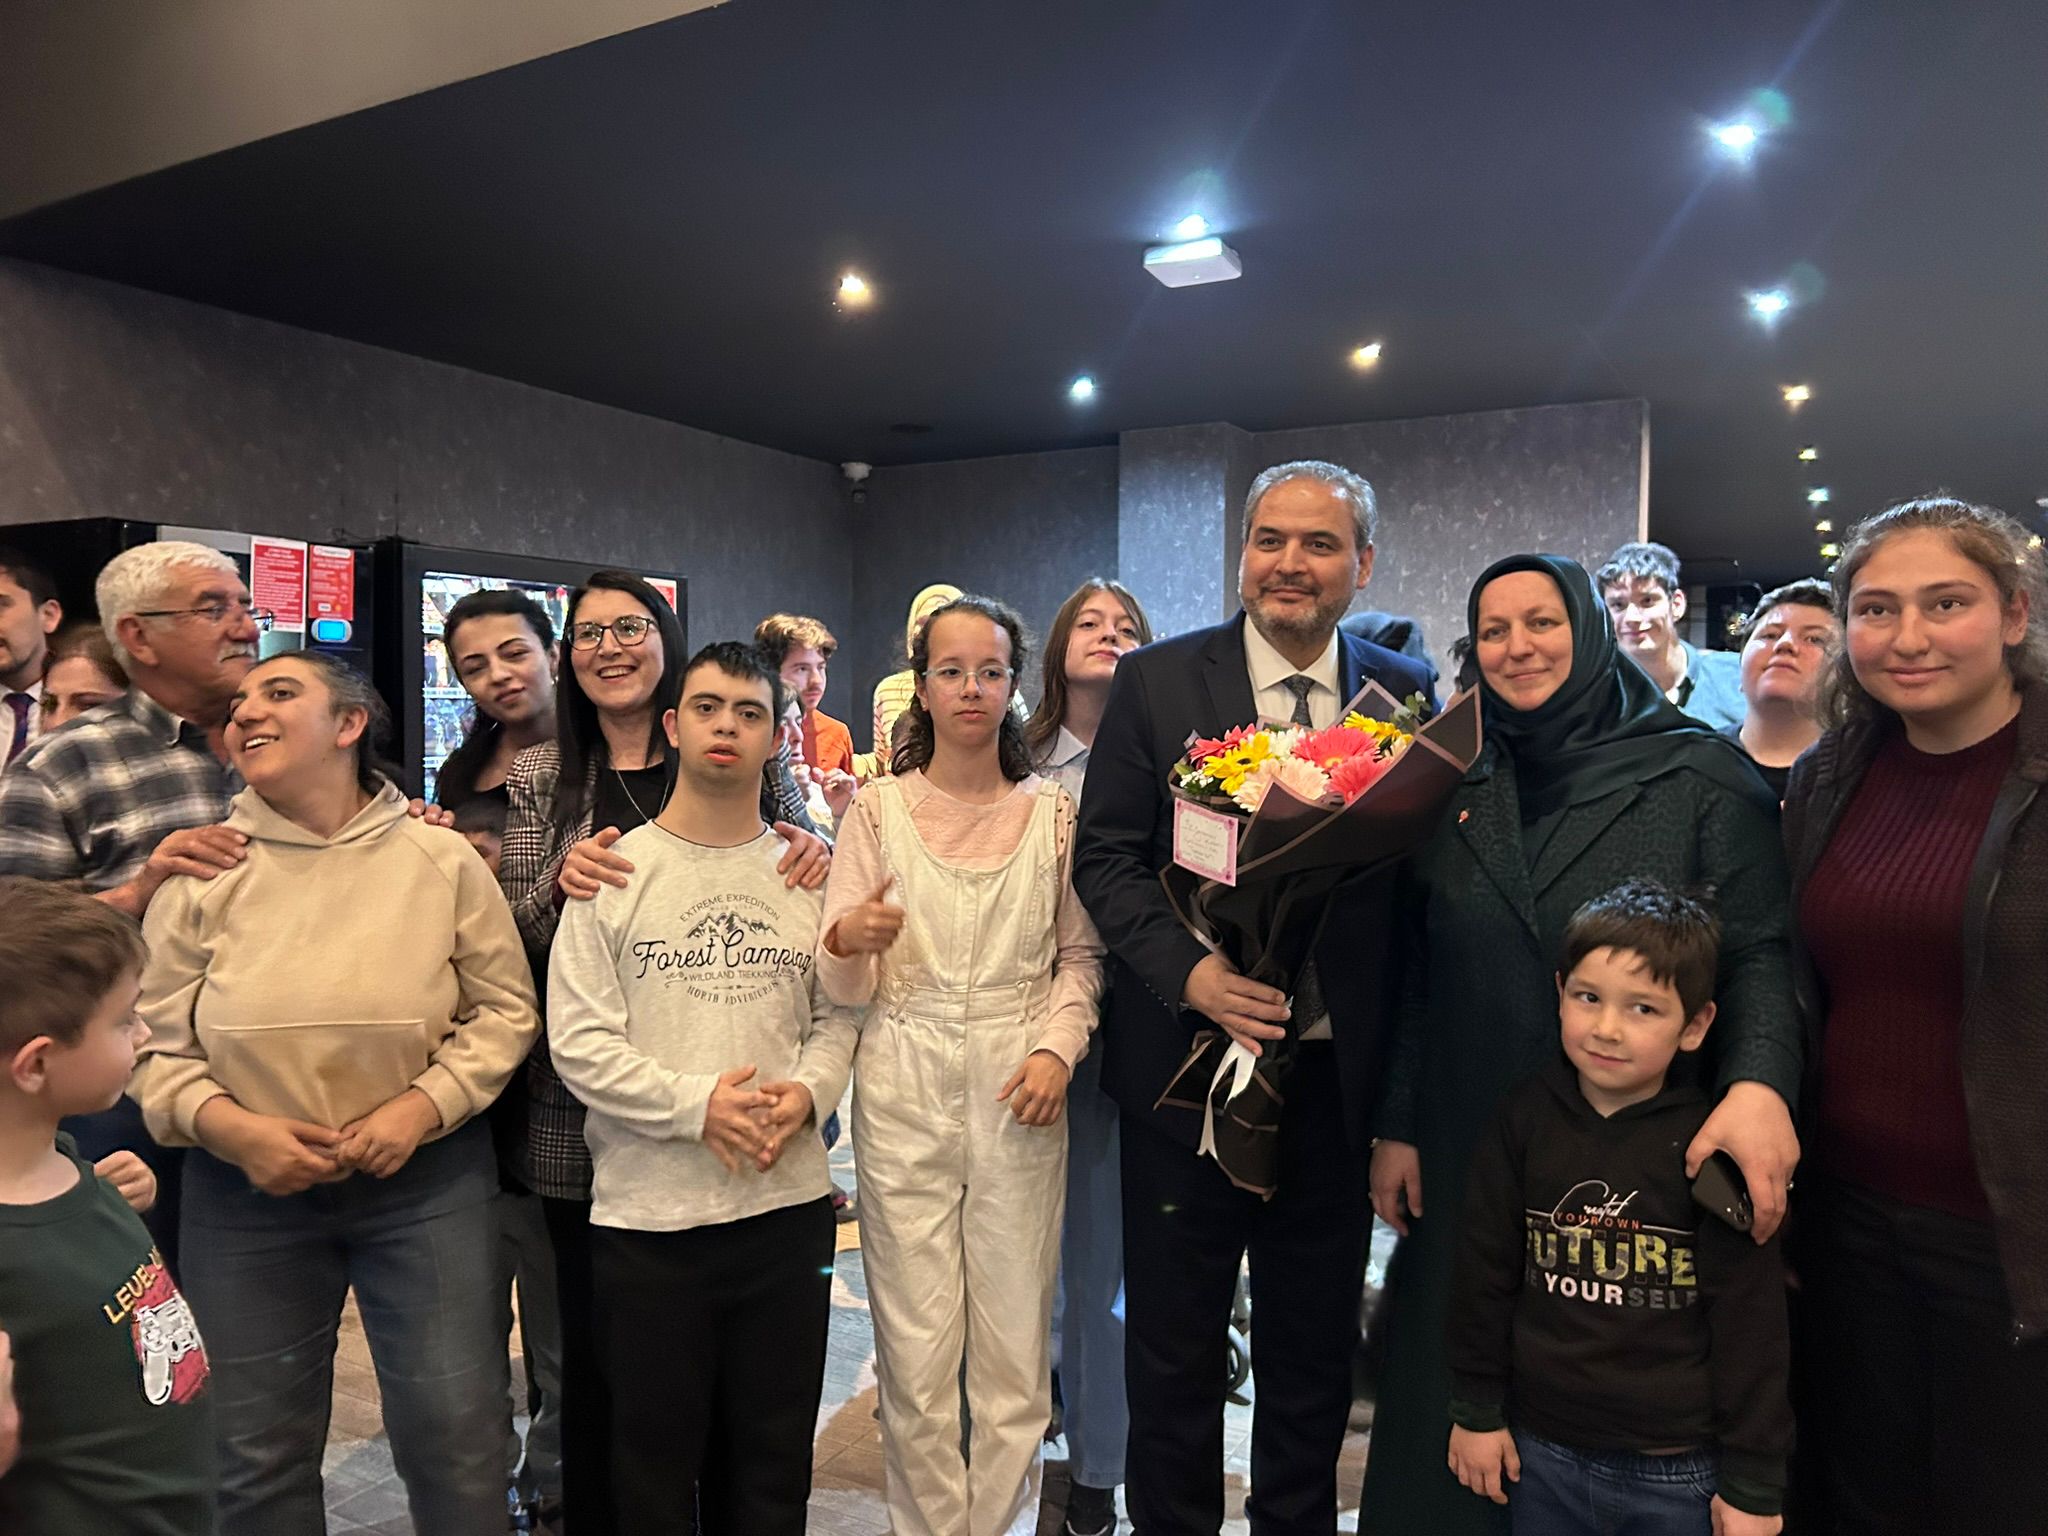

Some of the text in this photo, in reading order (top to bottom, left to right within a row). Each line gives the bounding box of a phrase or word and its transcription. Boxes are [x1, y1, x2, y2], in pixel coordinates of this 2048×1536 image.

[680, 894, 780, 922] EXTREME EXPEDITION
[633, 929, 812, 979] Forest Camping
[689, 969, 778, 981] WILDLAND TREKKING
[1556, 1211, 1640, 1230] YOUR OWN
